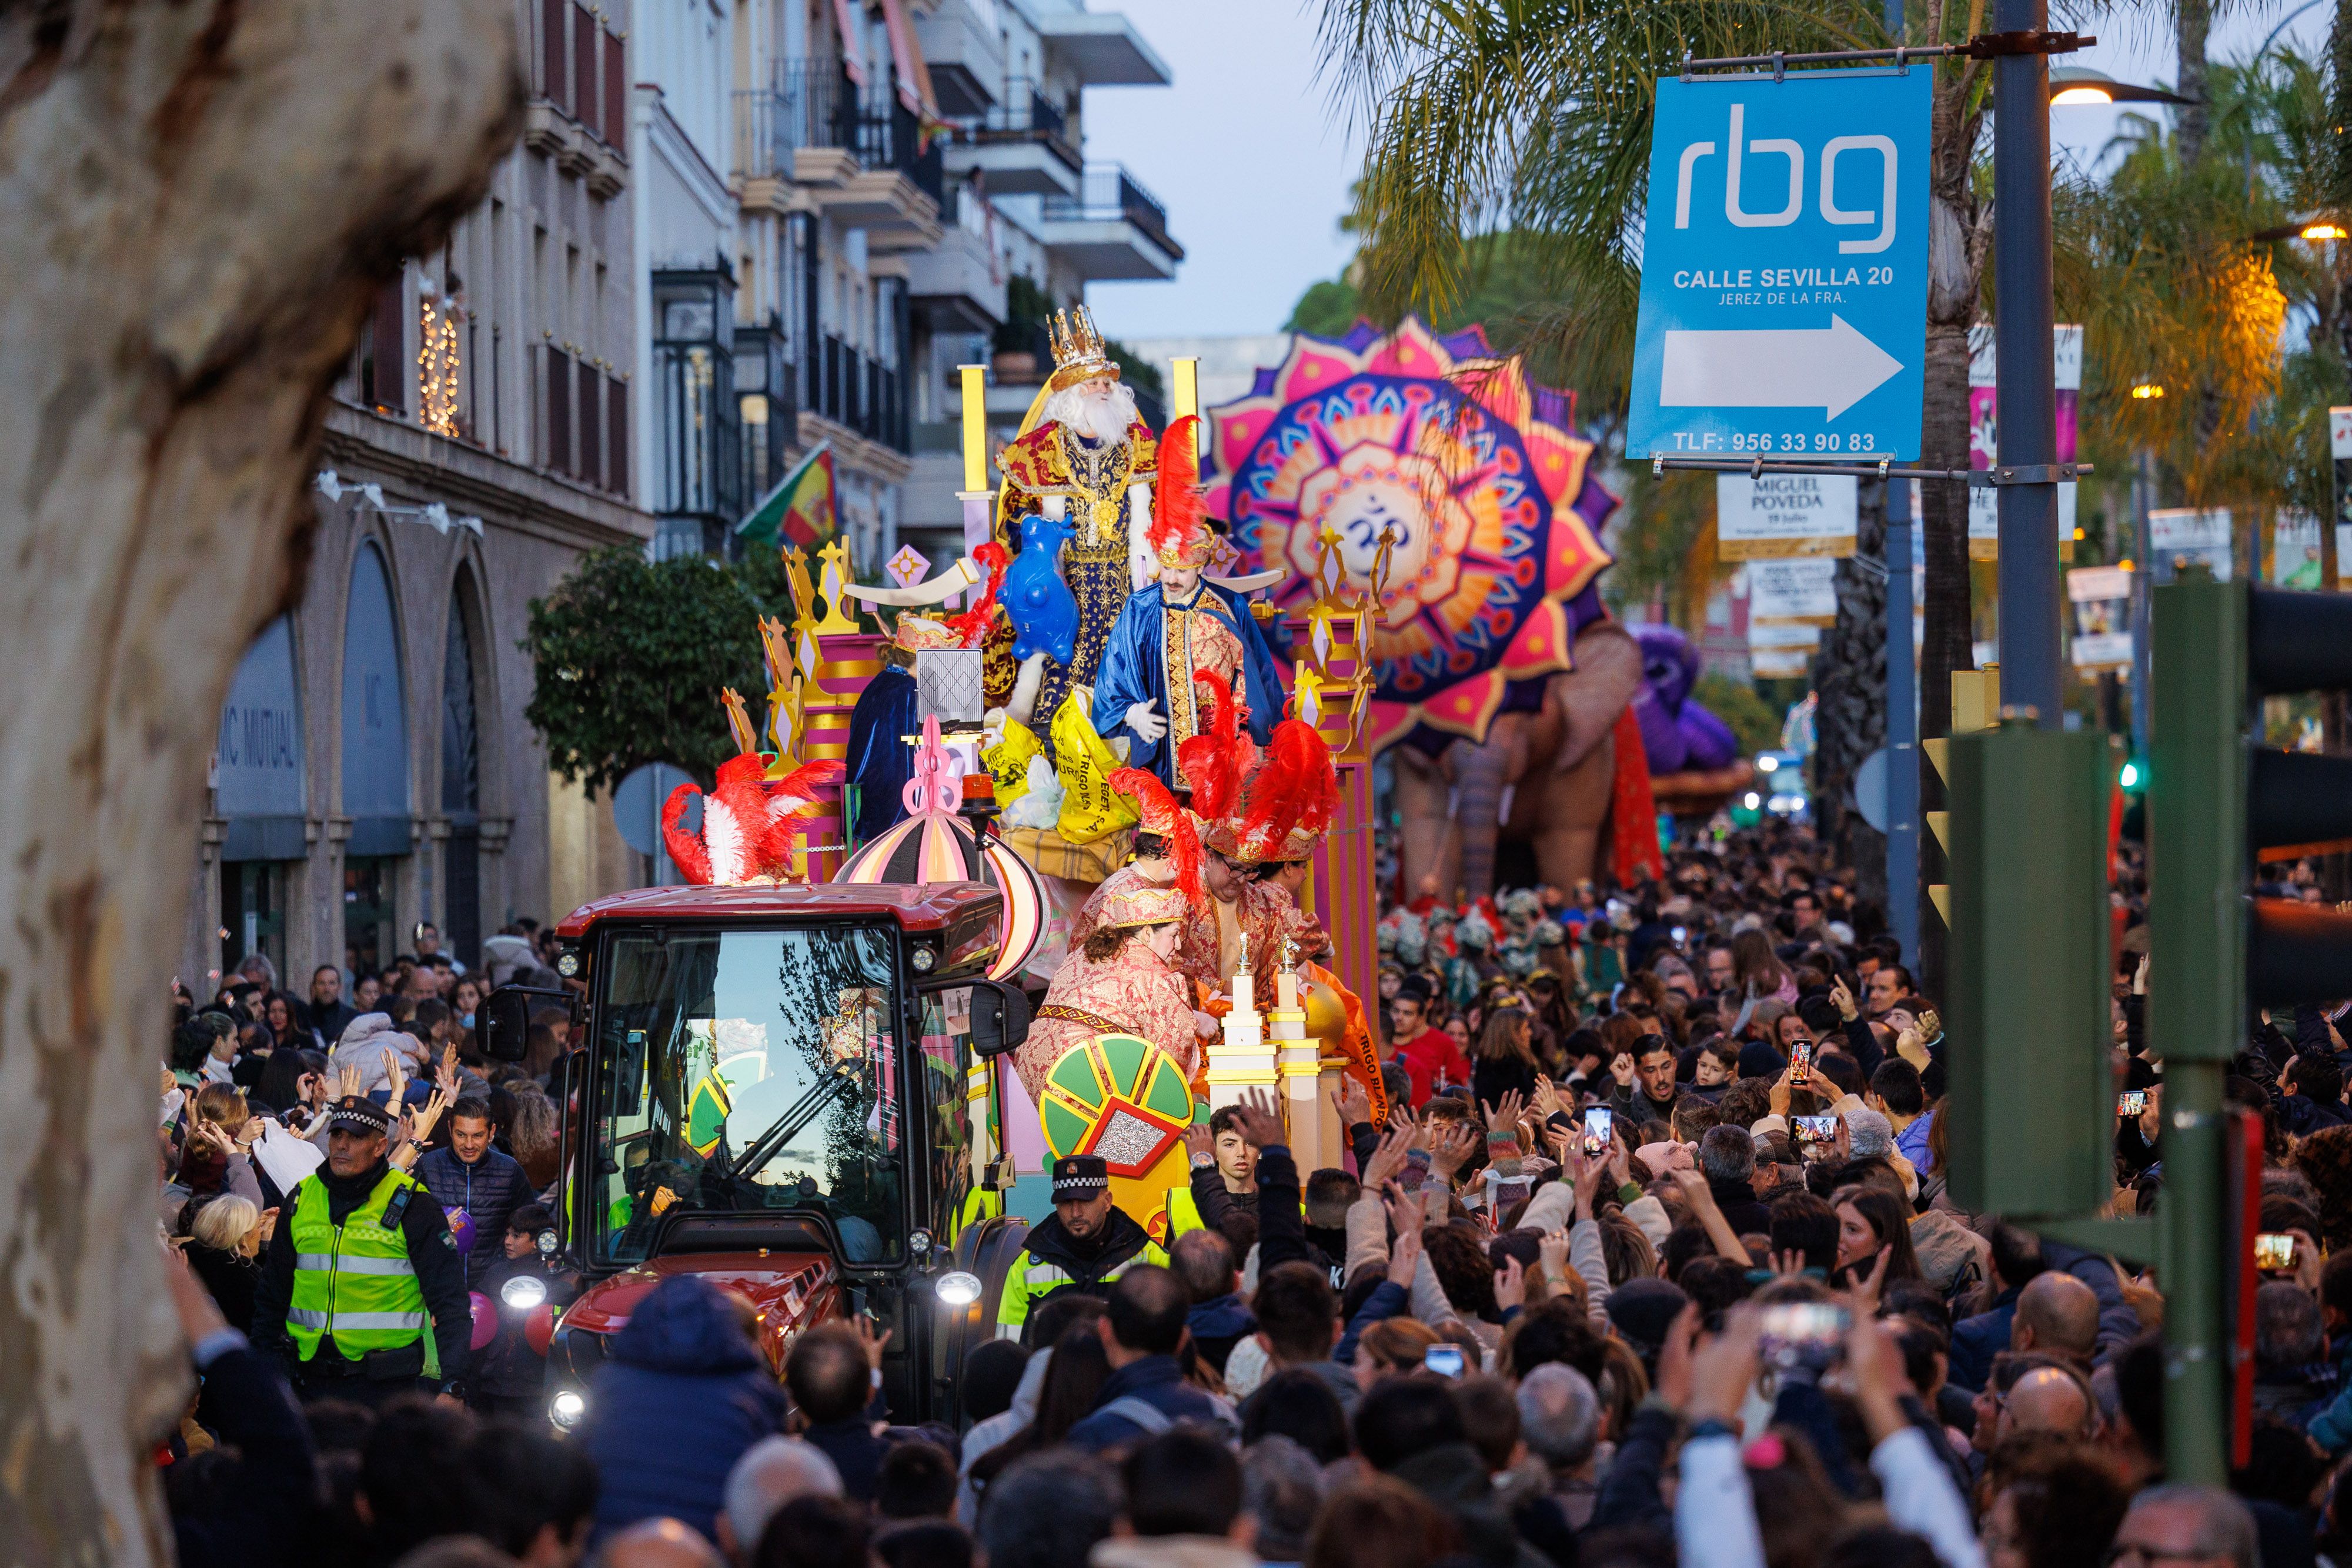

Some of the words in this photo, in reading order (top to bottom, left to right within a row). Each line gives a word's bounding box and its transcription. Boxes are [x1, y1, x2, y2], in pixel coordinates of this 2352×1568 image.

[1675, 103, 1897, 254] rbg
[1674, 270, 1752, 288] CALLE
[1760, 268, 1860, 287] SEVILLA
[1867, 267, 1893, 285] 20
[1719, 293, 1761, 305] JEREZ
[1768, 292, 1785, 305] DE
[1792, 292, 1809, 303] LA
[1815, 292, 1846, 303] FRA.
[1673, 432, 1723, 451] TLF:
[1732, 433, 1773, 452] 956
[1780, 433, 1806, 452] 33
[1815, 433, 1840, 452] 90
[1848, 433, 1875, 451] 83
[1754, 478, 1820, 493] MIGUEL
[1752, 494, 1822, 510] POVEDA
[243, 708, 294, 768] MUTUAL
[1079, 754, 1091, 791] TRIGO
[1360, 1032, 1377, 1075] TRIGO
[1369, 1076, 1387, 1128] BLANDO
